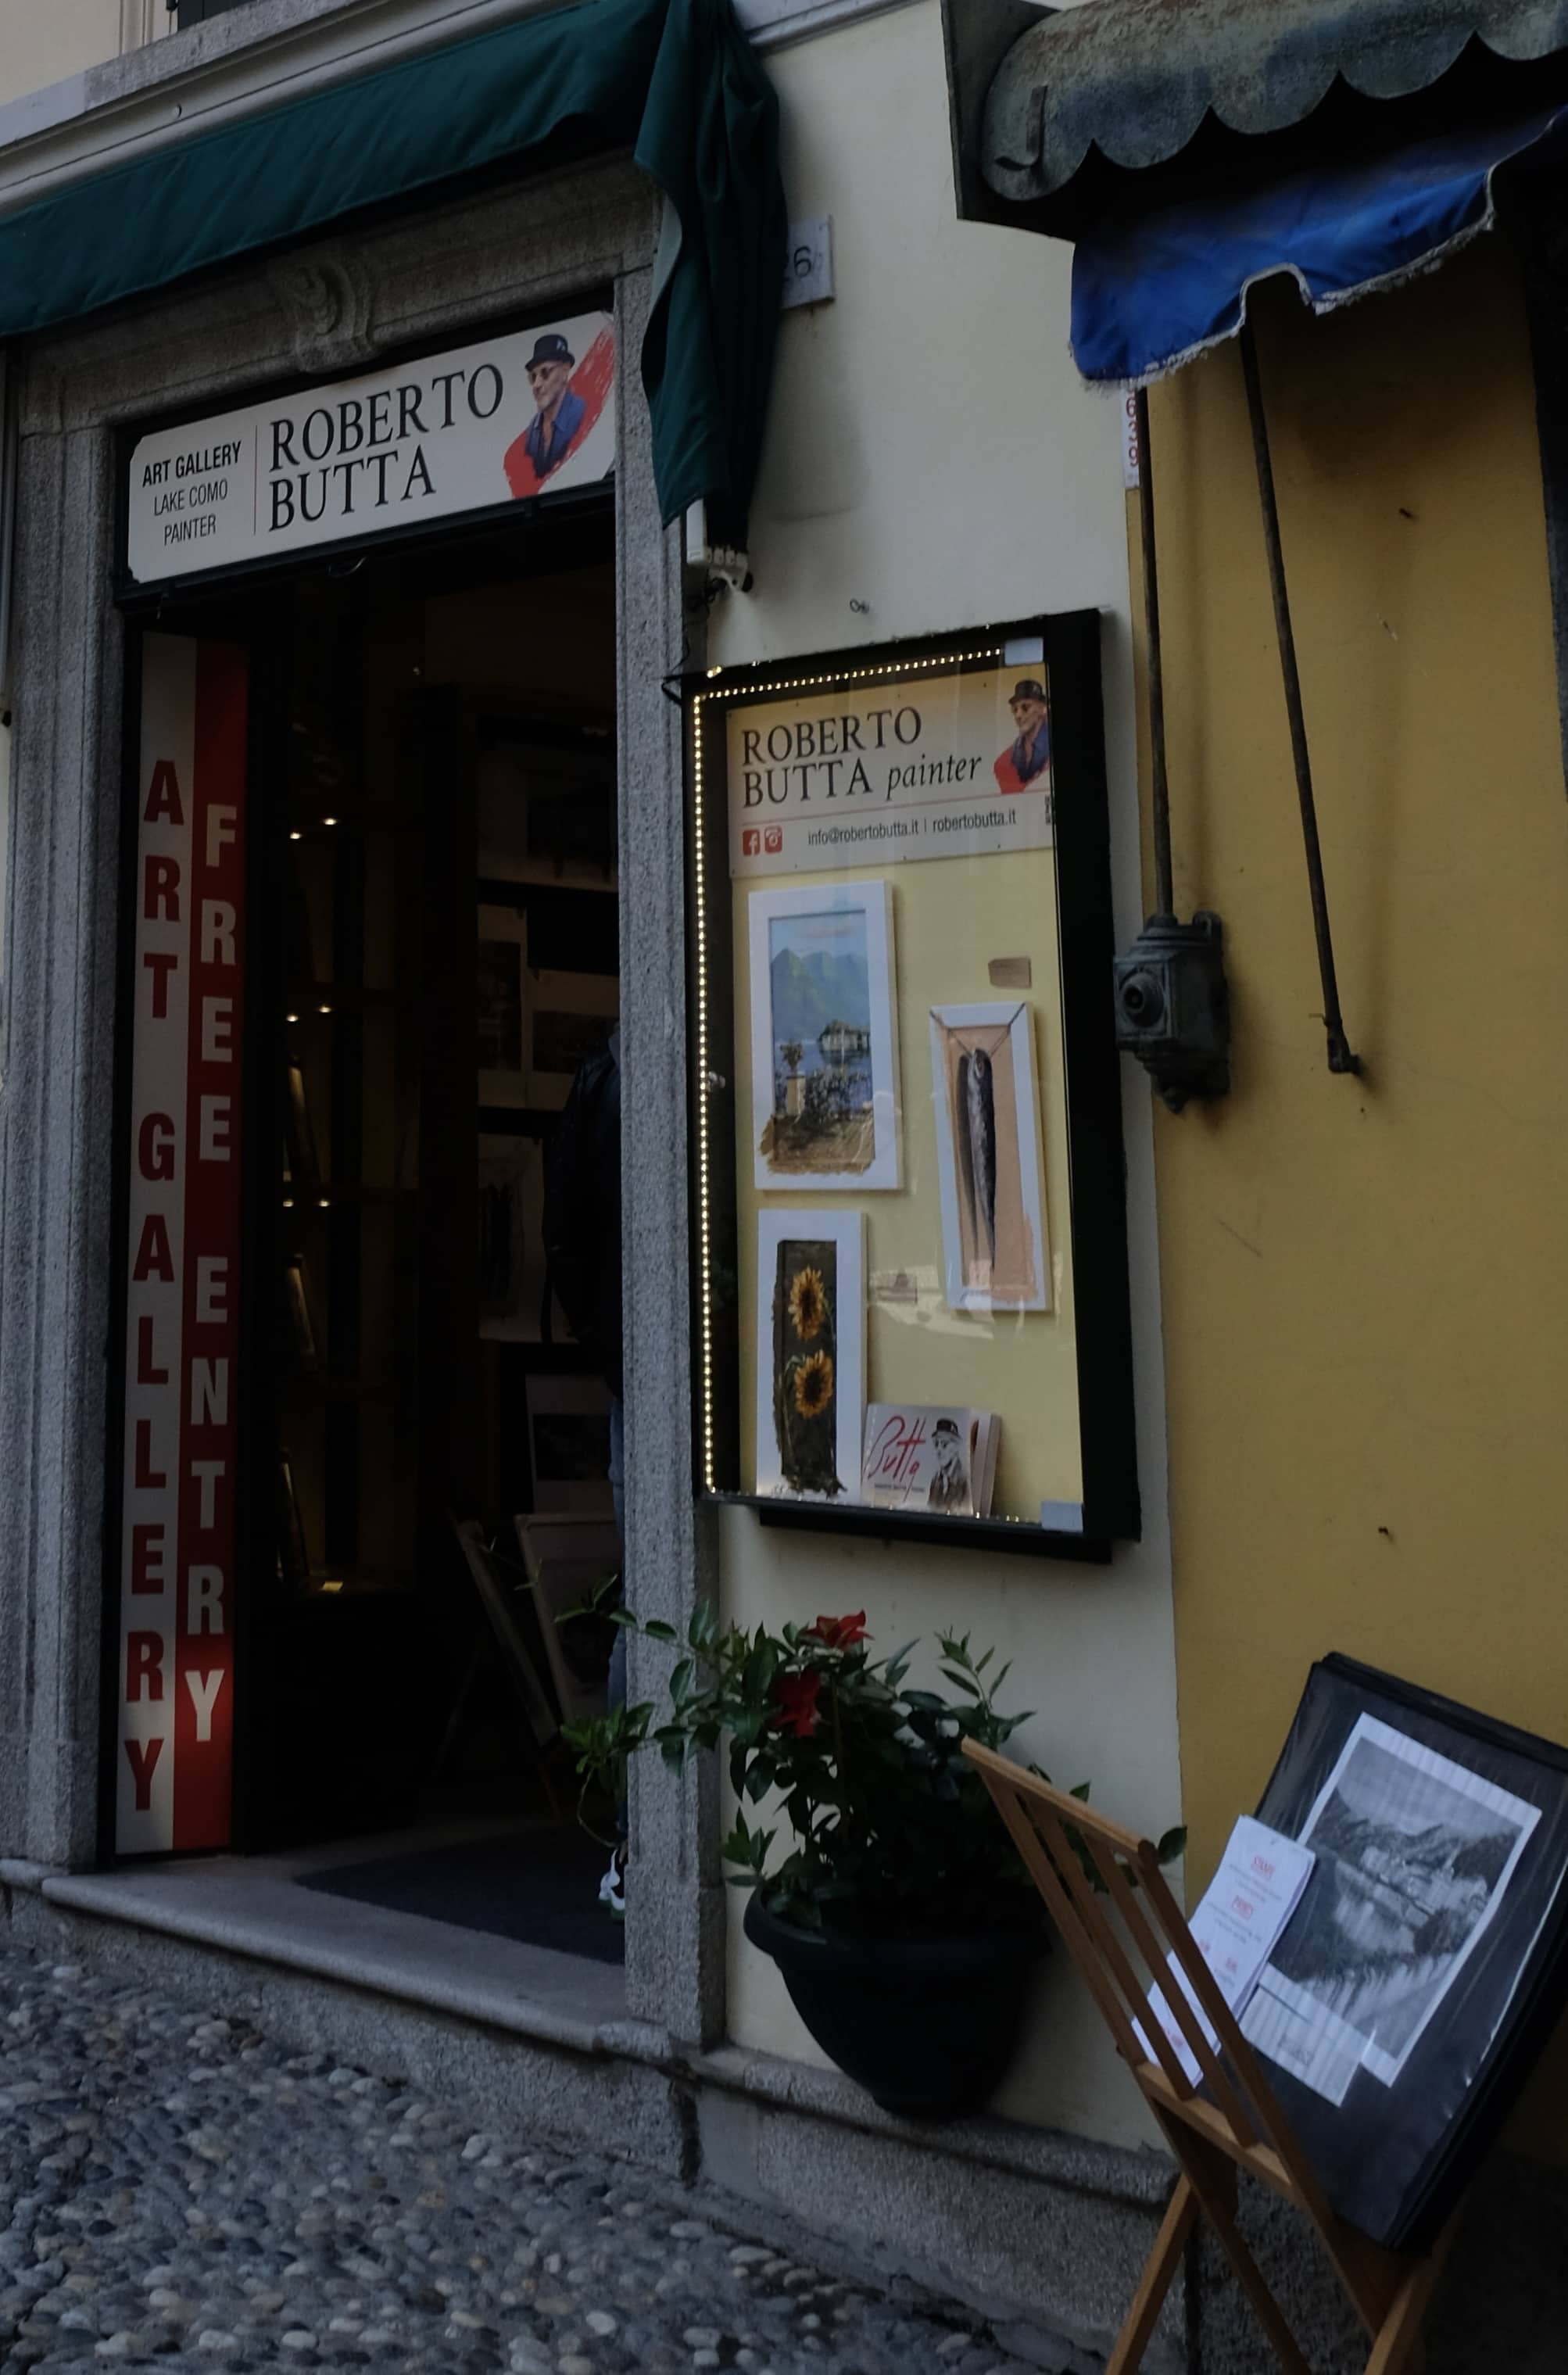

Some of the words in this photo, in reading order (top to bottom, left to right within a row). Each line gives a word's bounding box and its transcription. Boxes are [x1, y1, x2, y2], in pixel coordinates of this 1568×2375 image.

[270, 364, 503, 471] ROBERTO
[142, 460, 169, 487] ART
[175, 441, 242, 476] GALLERY
[154, 489, 184, 516] LAKE
[189, 478, 227, 508] COMO
[269, 444, 437, 532] BUTTA
[163, 514, 217, 545] PAINTER
[742, 707, 922, 766] ROBERTO
[743, 757, 874, 808] BUTTA
[886, 754, 983, 801] painter
[808, 819, 919, 846] info@robertobutta.it
[933, 808, 1017, 833] robertobutta.it
[143, 760, 184, 1019] ART
[199, 803, 238, 1162] FREE
[124, 1112, 175, 1811] GALLERY
[184, 1255, 229, 1743] ENTRY
